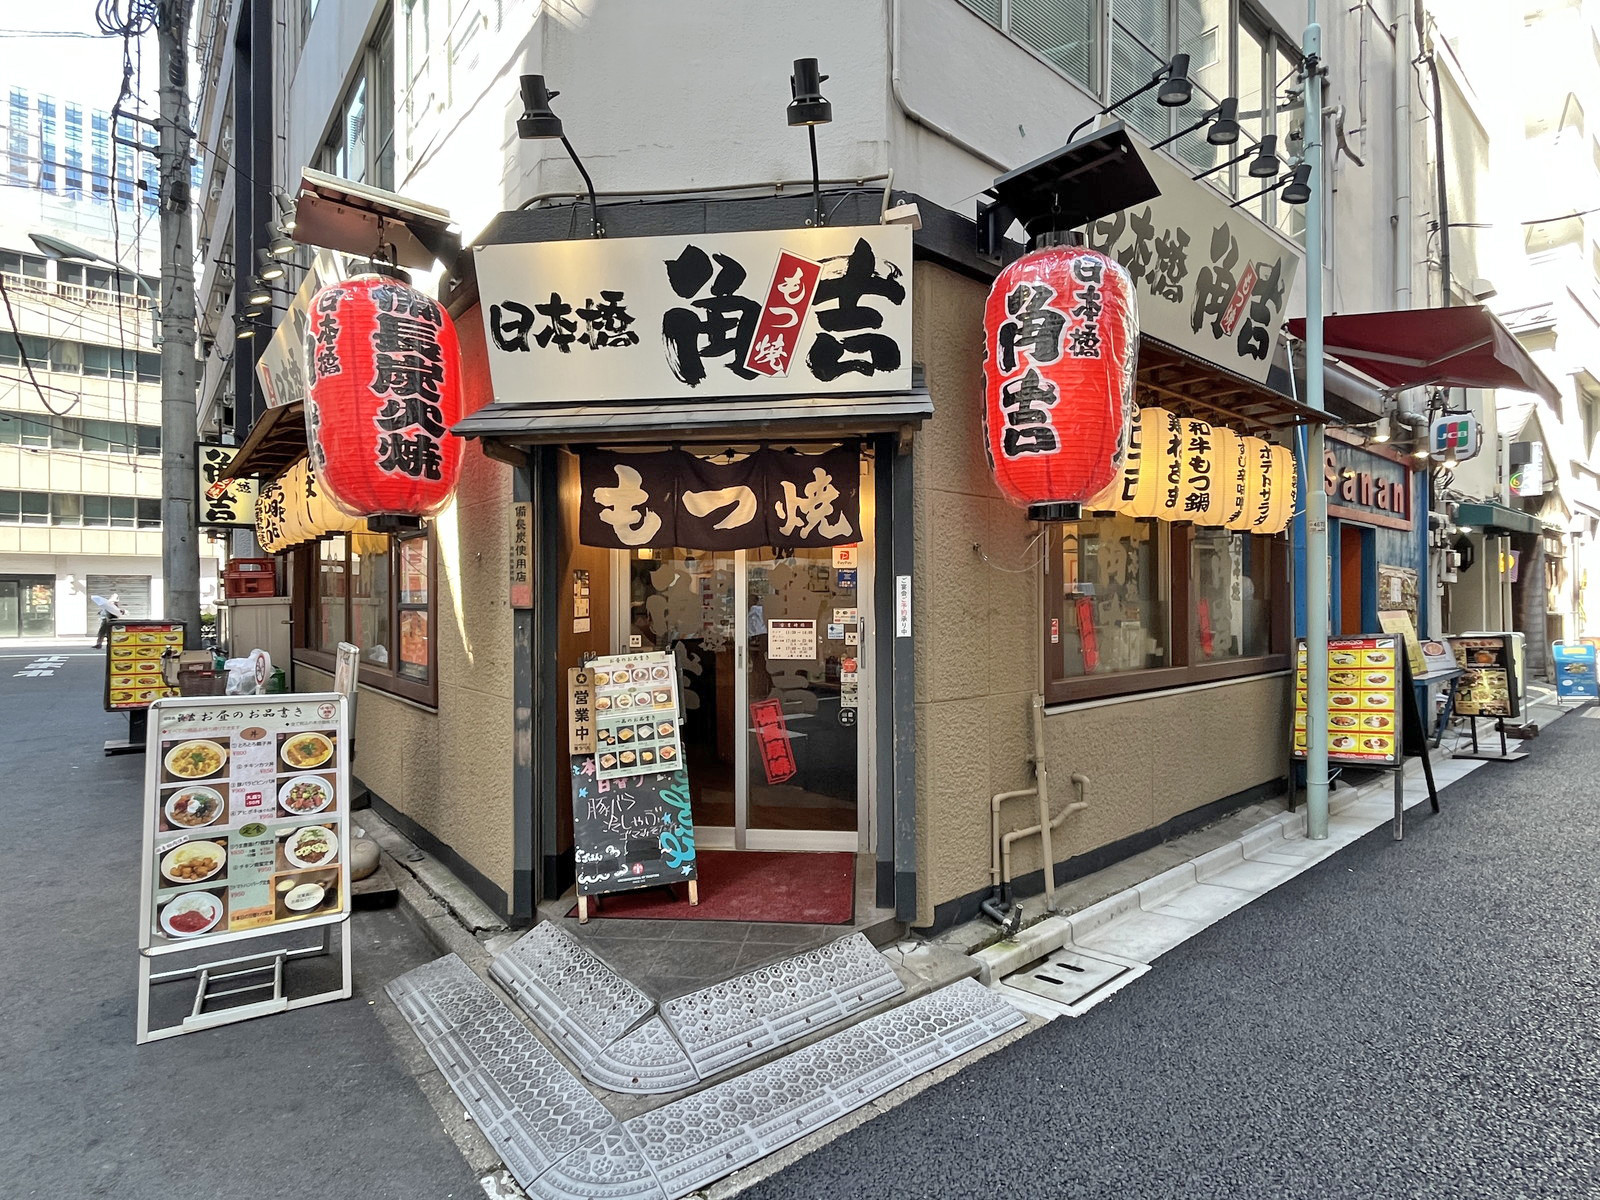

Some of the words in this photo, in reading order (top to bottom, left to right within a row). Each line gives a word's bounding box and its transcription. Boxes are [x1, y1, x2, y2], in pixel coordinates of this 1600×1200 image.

[1087, 206, 1190, 303] 日本橋
[317, 290, 343, 376] 日本橋
[489, 290, 640, 353] 日本橋
[663, 237, 905, 388] 角吉
[755, 267, 804, 377] もつ焼
[1071, 257, 1102, 358] 日本橋
[999, 284, 1066, 457] 角吉
[1184, 421, 1212, 513] 和牛もつ鍋
[1437, 430, 1468, 440] JCB
[592, 464, 854, 546] もつ焼
[1325, 449, 1405, 514] Sanan
[515, 505, 527, 582] 備長炭使用店
[201, 706, 303, 722] お昼のお品書き
[574, 690, 590, 741] 営業中
